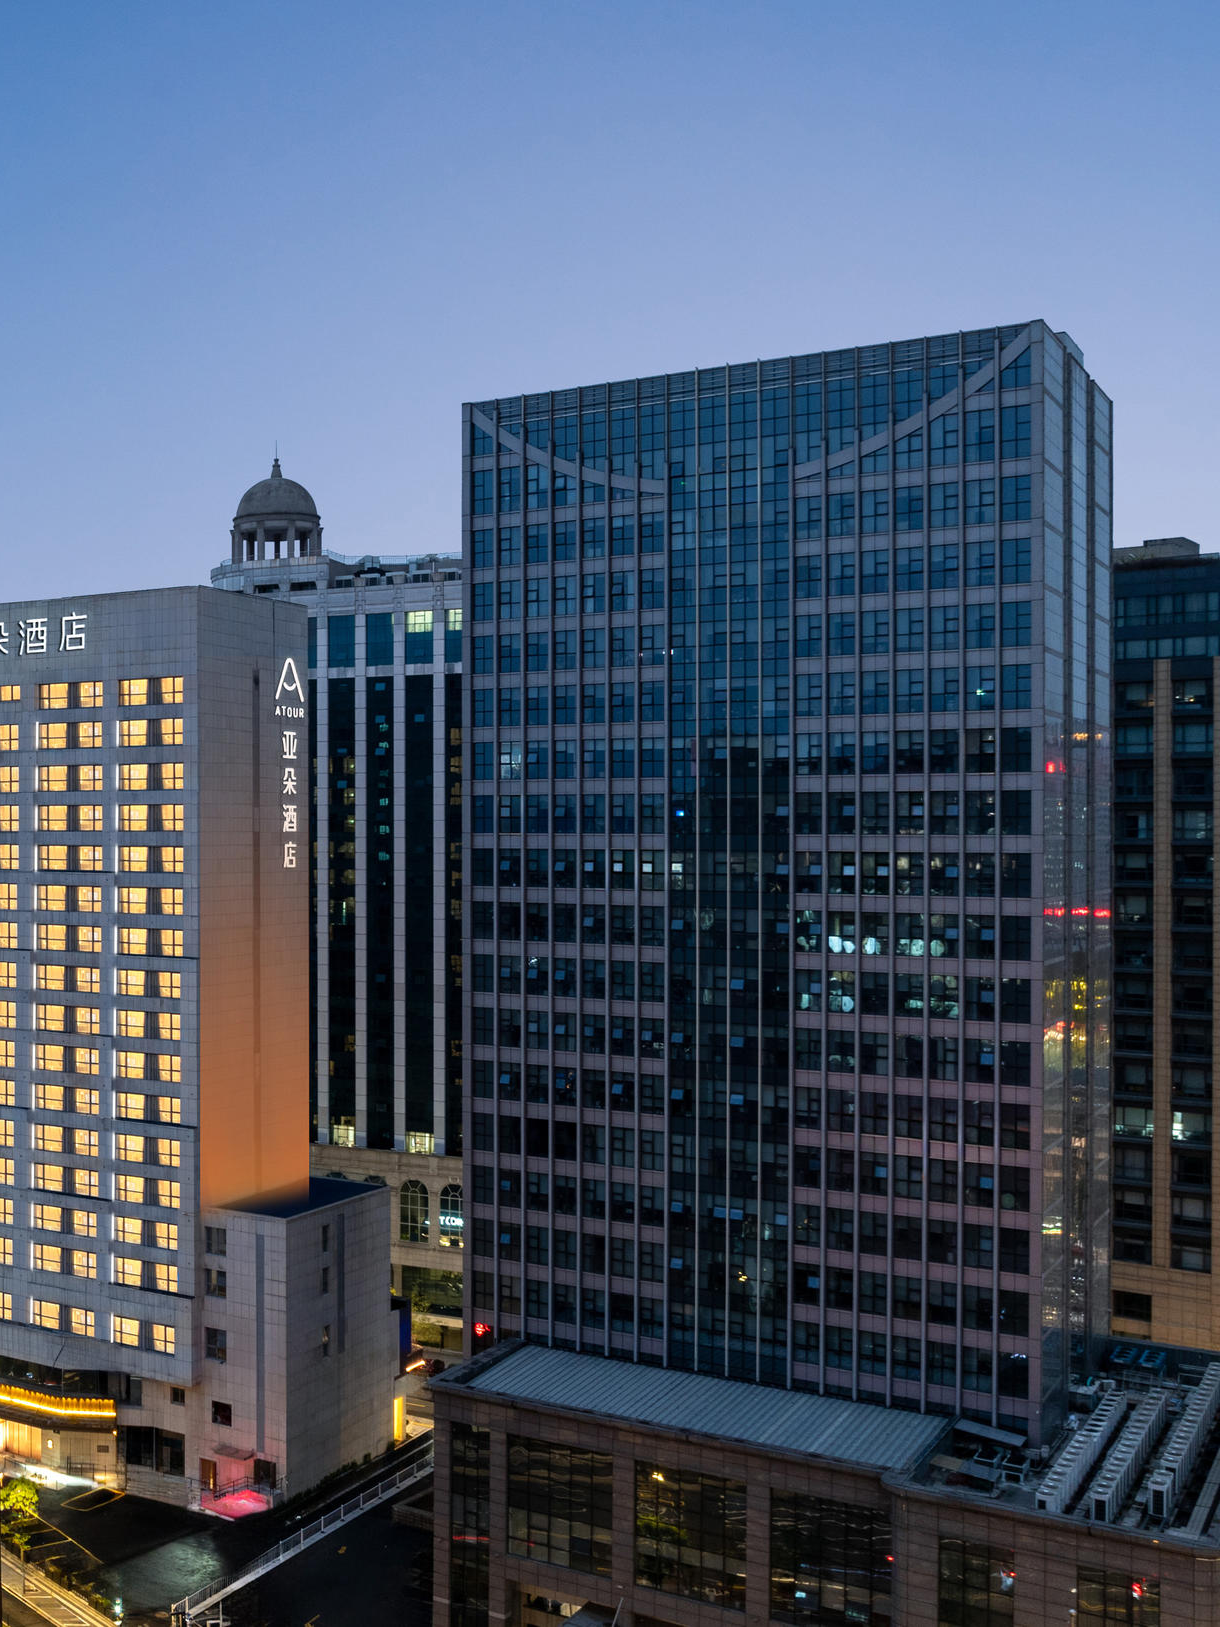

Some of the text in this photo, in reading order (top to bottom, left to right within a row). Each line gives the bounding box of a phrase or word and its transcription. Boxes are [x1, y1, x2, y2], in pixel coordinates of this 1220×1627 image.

[274, 705, 305, 719] ATOUR
[282, 730, 298, 869] 亚朵酒店
